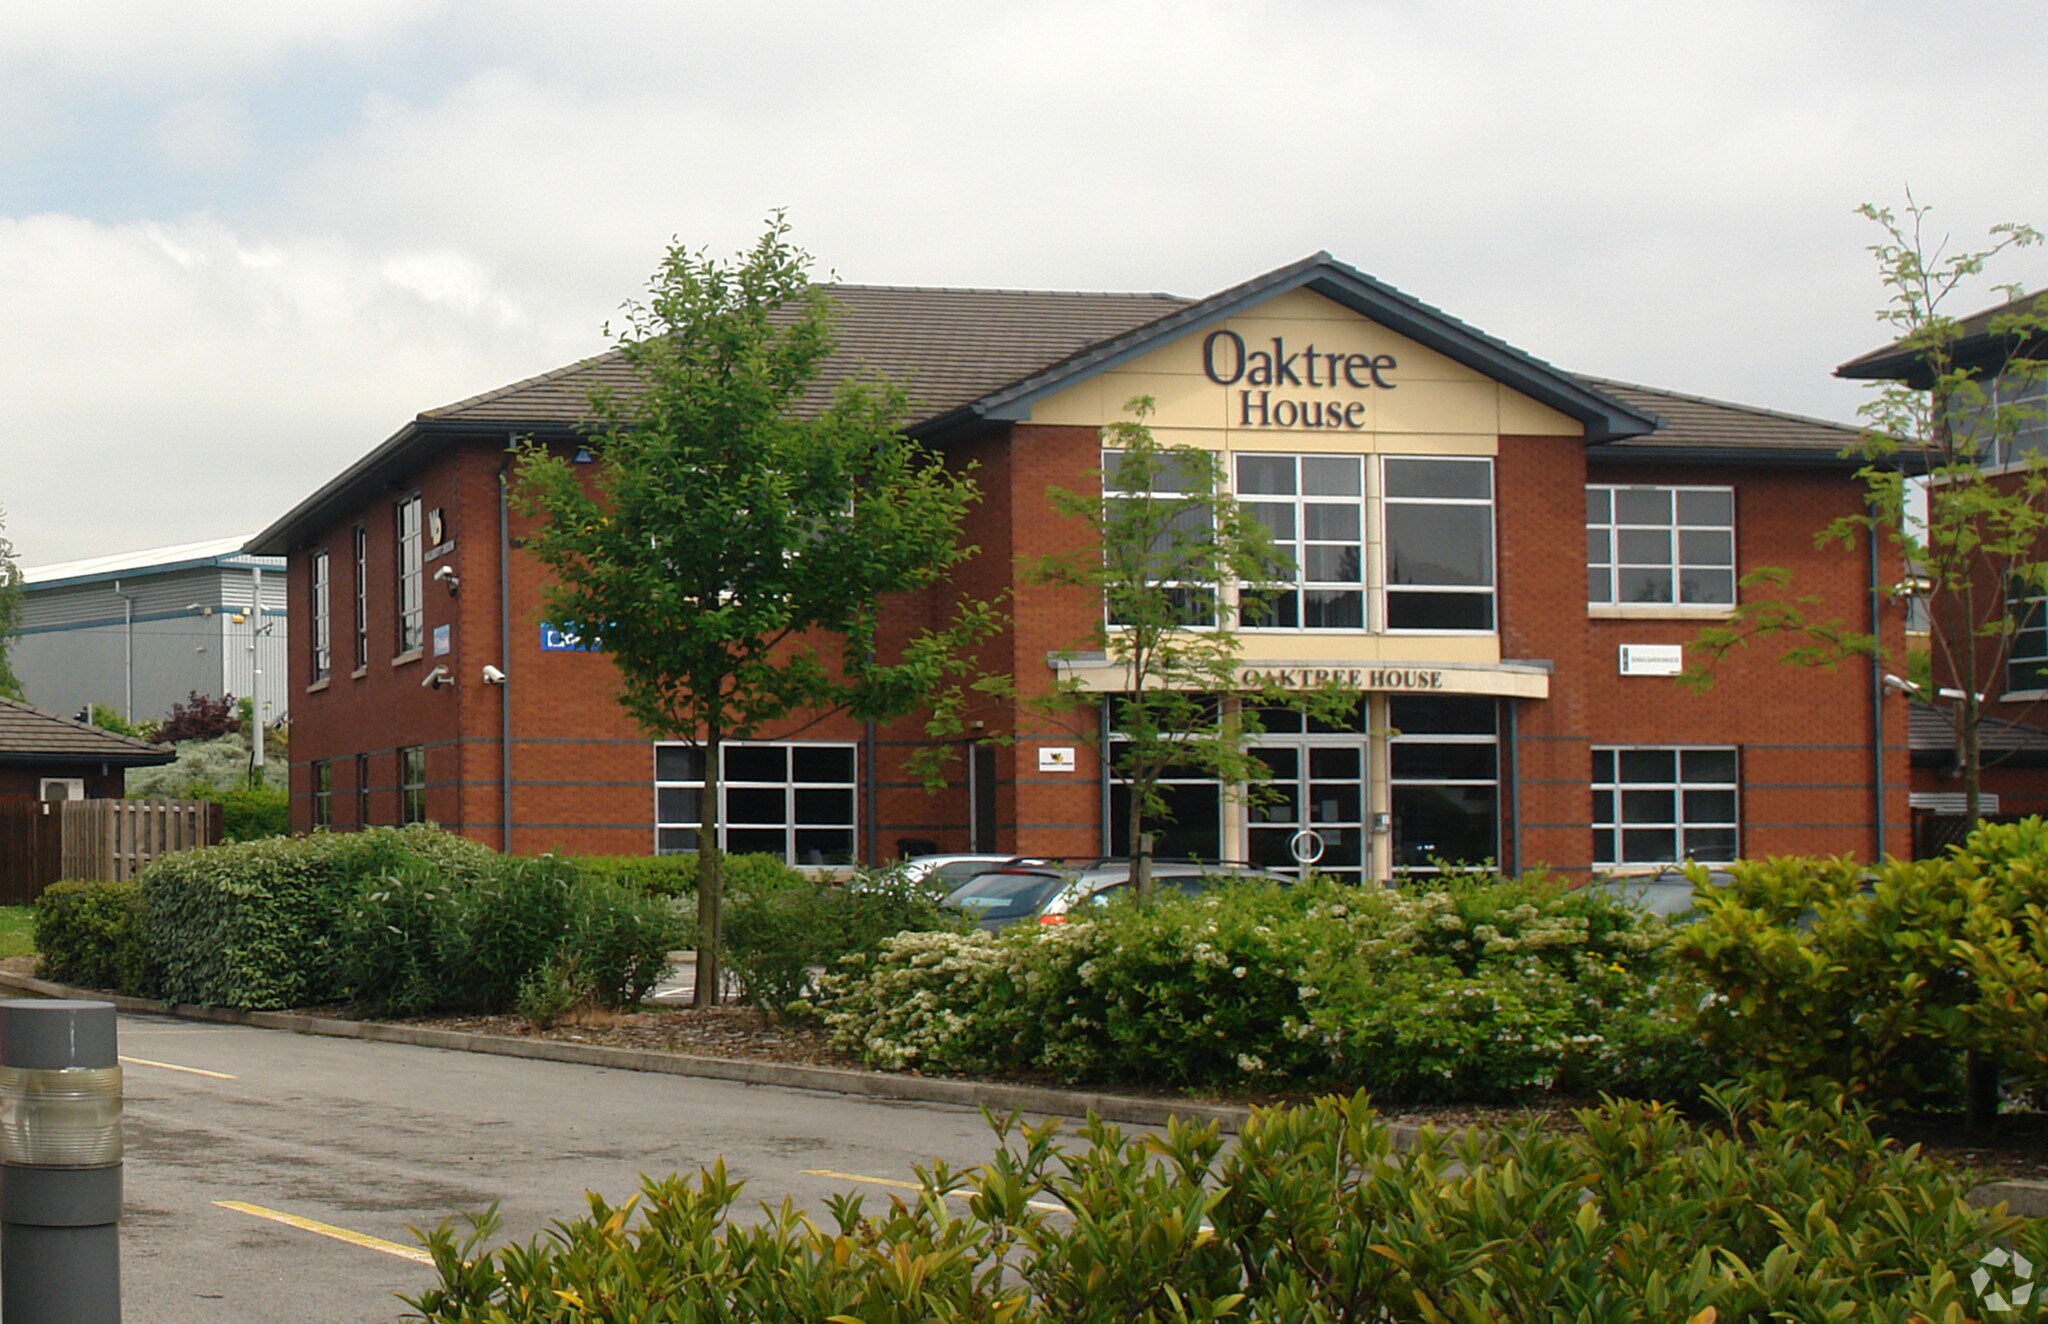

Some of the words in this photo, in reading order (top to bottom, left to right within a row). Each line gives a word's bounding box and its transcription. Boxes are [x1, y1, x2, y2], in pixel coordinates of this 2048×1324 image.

[1203, 329, 1397, 388] Oaktree
[1239, 390, 1366, 428] House
[1242, 668, 1362, 688] OAKTREE
[1370, 670, 1443, 689] HOUSE
